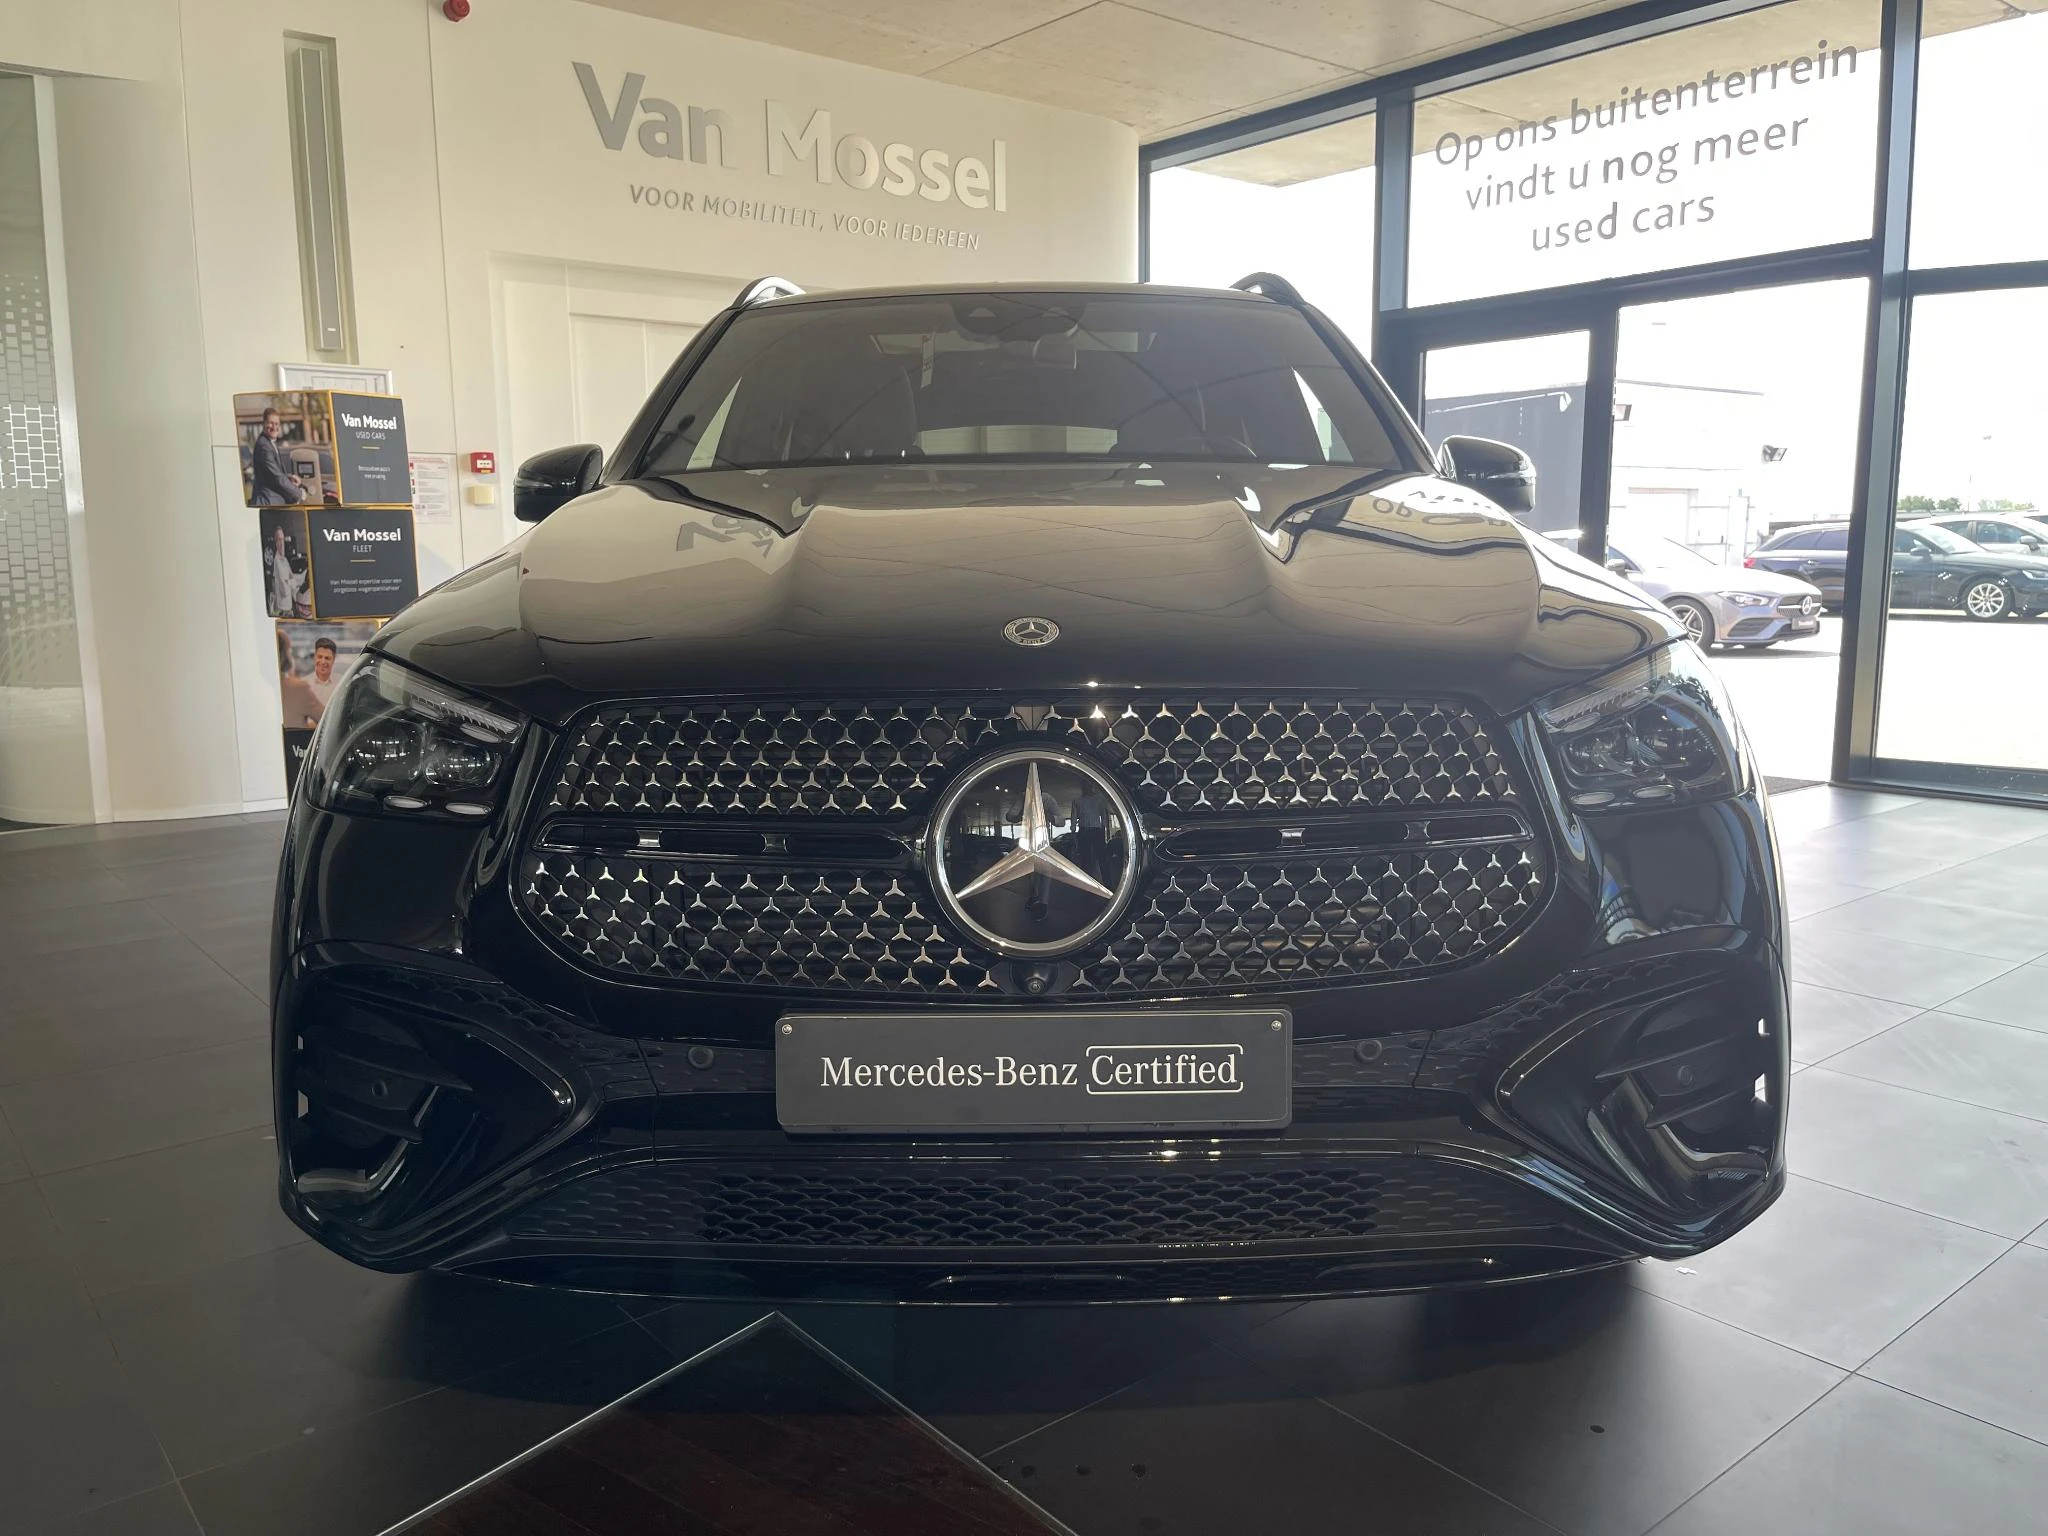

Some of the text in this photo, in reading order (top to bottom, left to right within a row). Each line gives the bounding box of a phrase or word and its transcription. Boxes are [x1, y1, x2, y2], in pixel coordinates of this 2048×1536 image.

[1435, 39, 1857, 171] Op ons buitenterrein
[571, 60, 1007, 212] Van Mossel
[1465, 117, 1809, 211] vindt u nog meer
[630, 184, 980, 251] VOOR MOBILITEIT, VOOR IEDEREEN
[1532, 195, 1716, 252] used cars
[341, 413, 397, 430] Van Mossel
[355, 431, 386, 440] USED CARS
[322, 527, 401, 541] Van Mossel
[352, 544, 373, 553] FLEET
[820, 1053, 1238, 1088] Mercedes-Benz Certified
